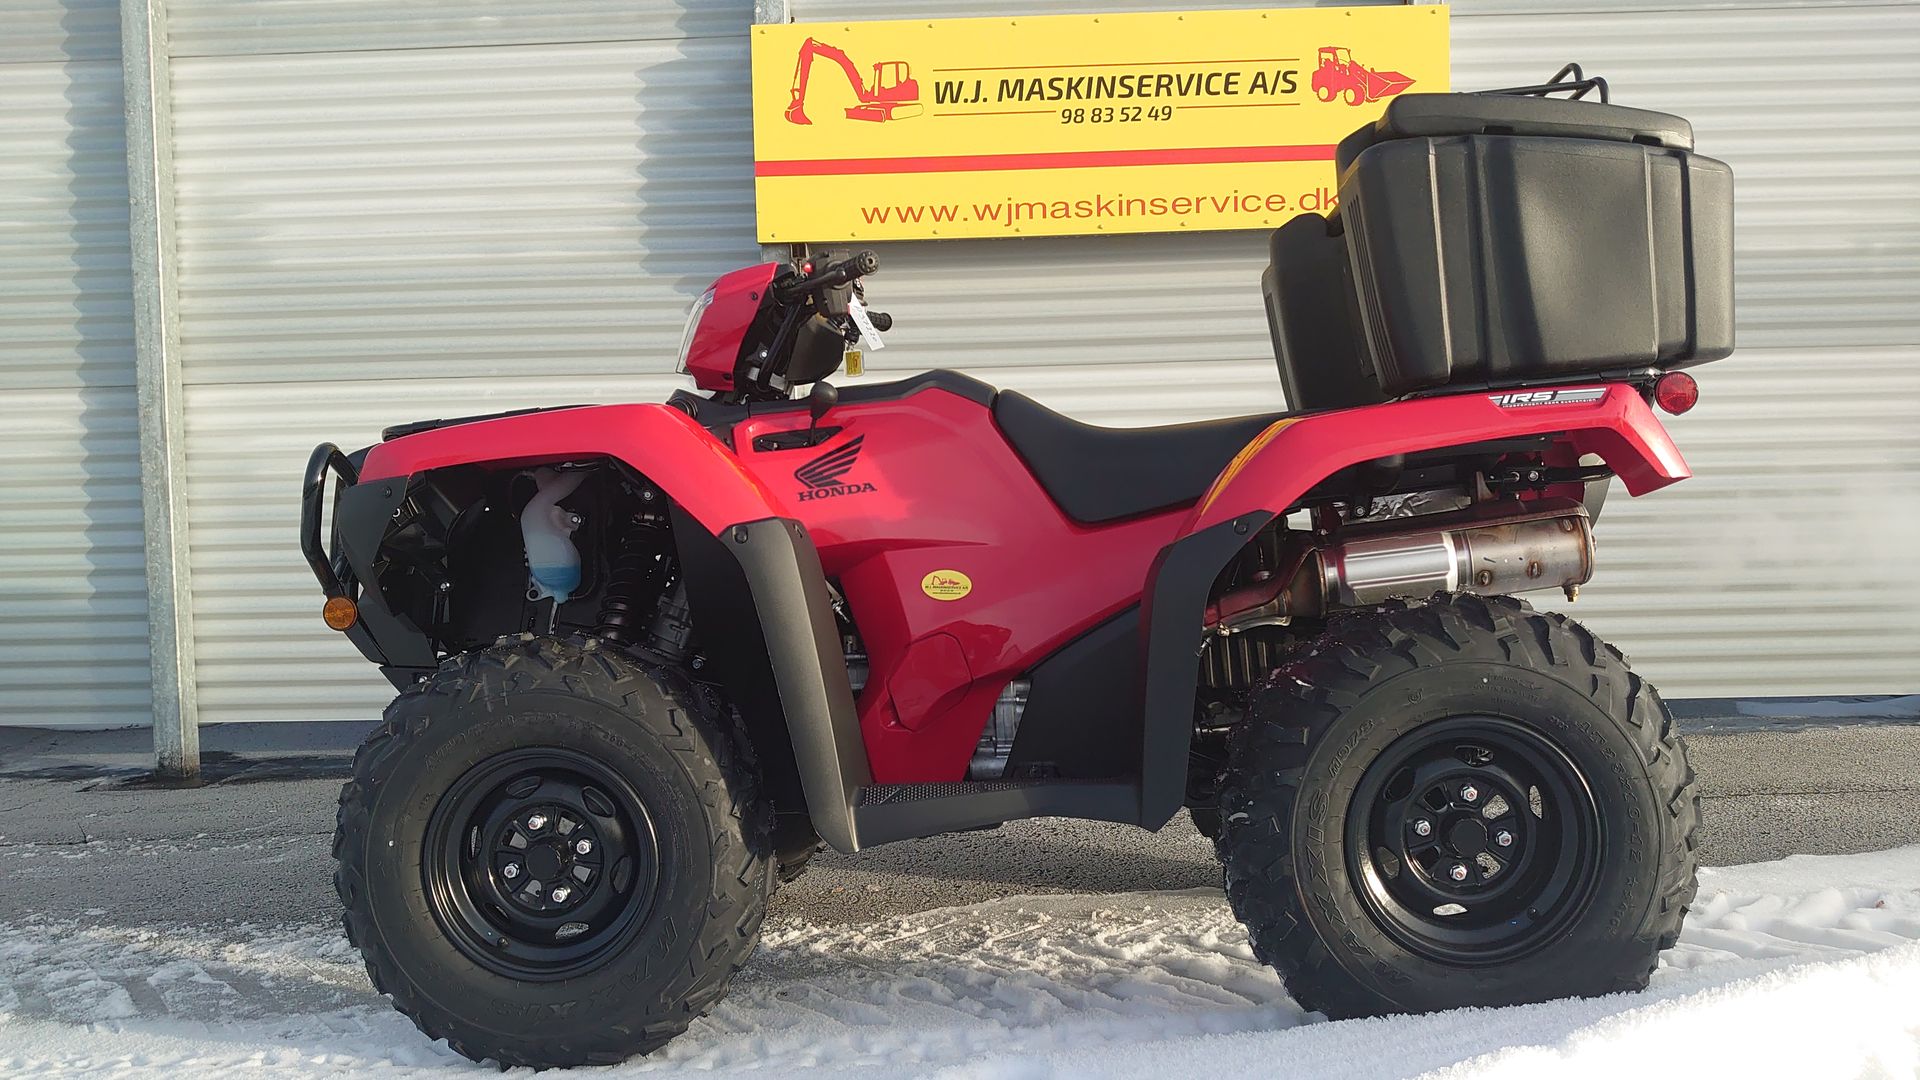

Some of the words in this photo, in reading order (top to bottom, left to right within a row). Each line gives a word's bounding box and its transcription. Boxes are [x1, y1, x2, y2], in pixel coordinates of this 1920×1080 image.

[934, 80, 988, 105] W.J.
[997, 74, 1241, 103] MASKINSERVICE
[1247, 70, 1298, 96] A/S
[1061, 108, 1085, 124] 98
[1090, 107, 1114, 123] 83
[1119, 106, 1142, 123] 52
[1147, 105, 1172, 121] 49
[860, 187, 1339, 227] www.wjmaskinservice.dk
[1502, 391, 1554, 404] IRS
[798, 482, 878, 502] HONDA
